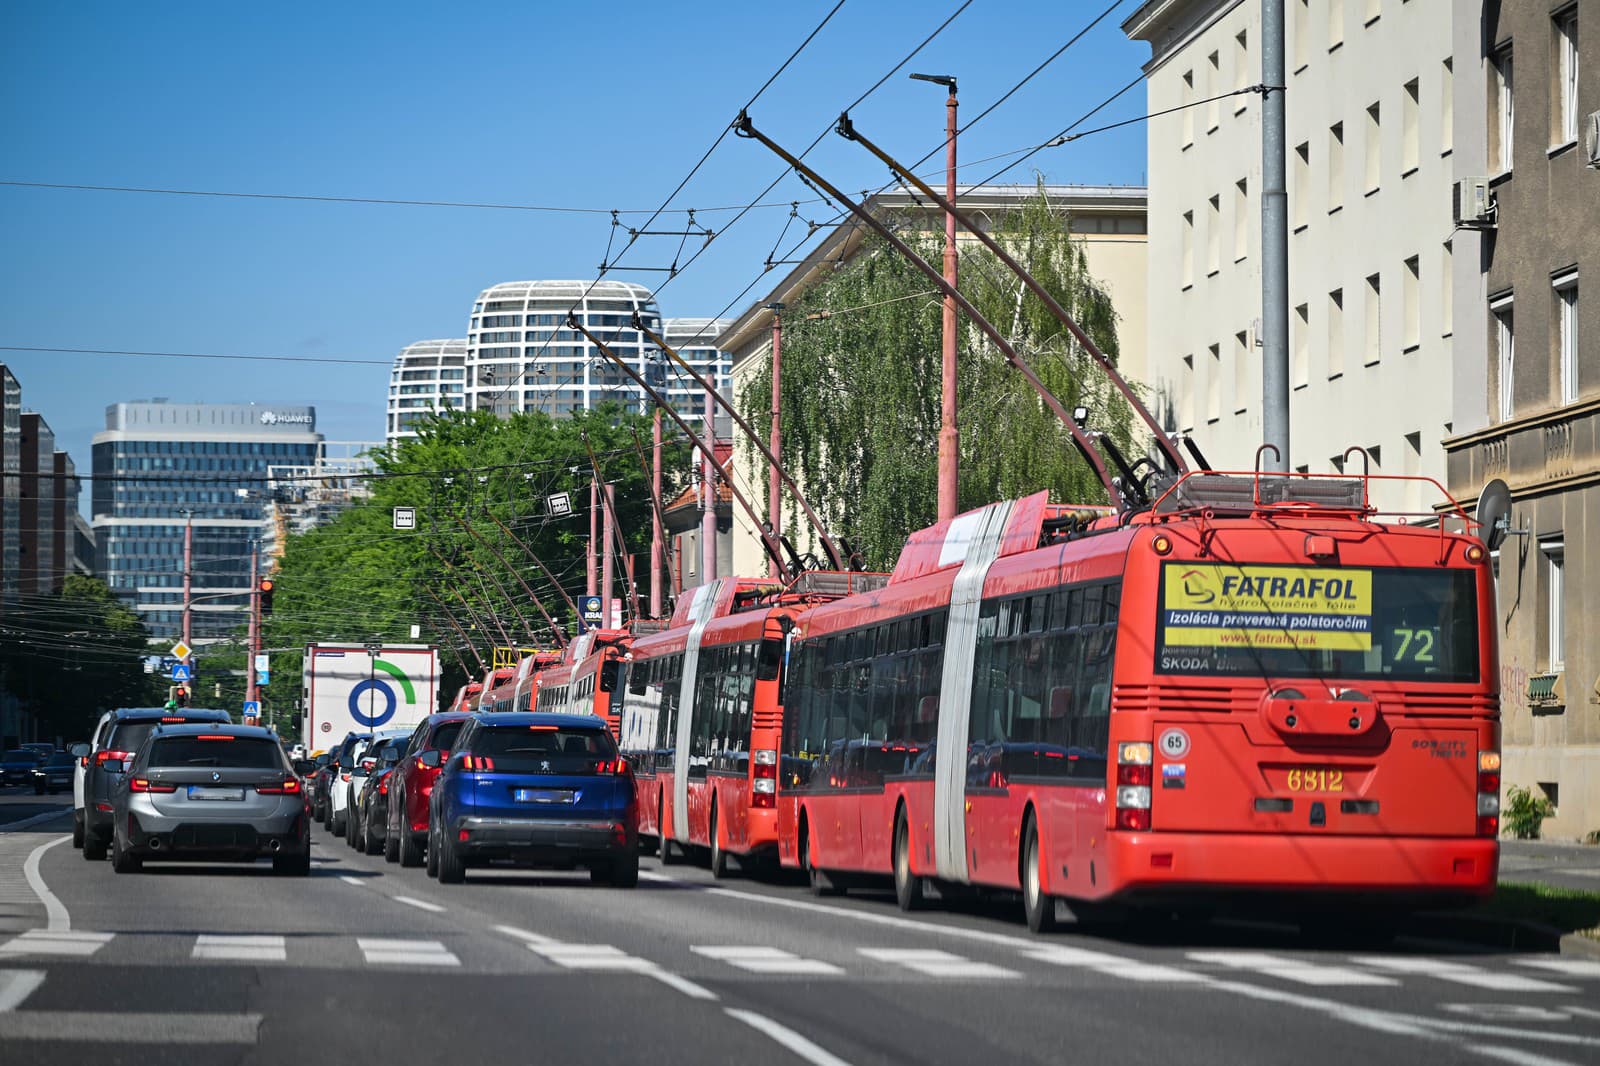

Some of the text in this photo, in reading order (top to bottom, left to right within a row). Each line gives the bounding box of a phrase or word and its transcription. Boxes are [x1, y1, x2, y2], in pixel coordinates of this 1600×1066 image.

[278, 415, 312, 423] HUAWEI
[1221, 575, 1357, 599] FATRAFOL
[1169, 611, 1219, 625] Izolácia
[1290, 614, 1367, 630] polstoročím
[1220, 632, 1317, 645] www.fatrafol.sk
[1394, 629, 1433, 661] 72
[1168, 735, 1182, 749] 65
[1287, 769, 1343, 791] 6812
